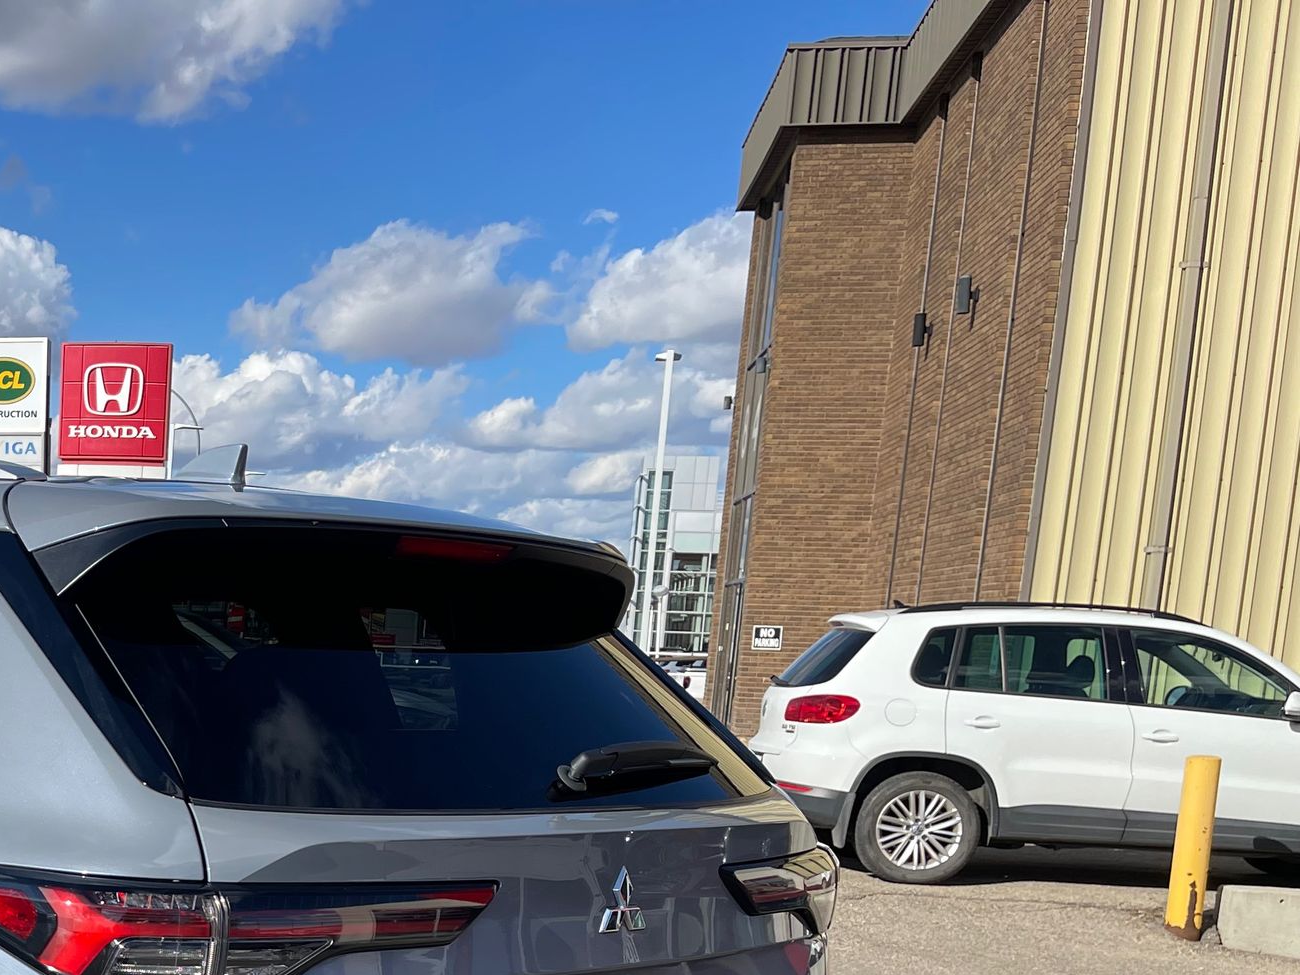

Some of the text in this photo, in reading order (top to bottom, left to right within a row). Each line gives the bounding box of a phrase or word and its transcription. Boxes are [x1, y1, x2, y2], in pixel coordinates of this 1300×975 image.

[67, 425, 156, 439] HONDA
[760, 628, 775, 638] NO
[754, 637, 780, 648] PARKING
